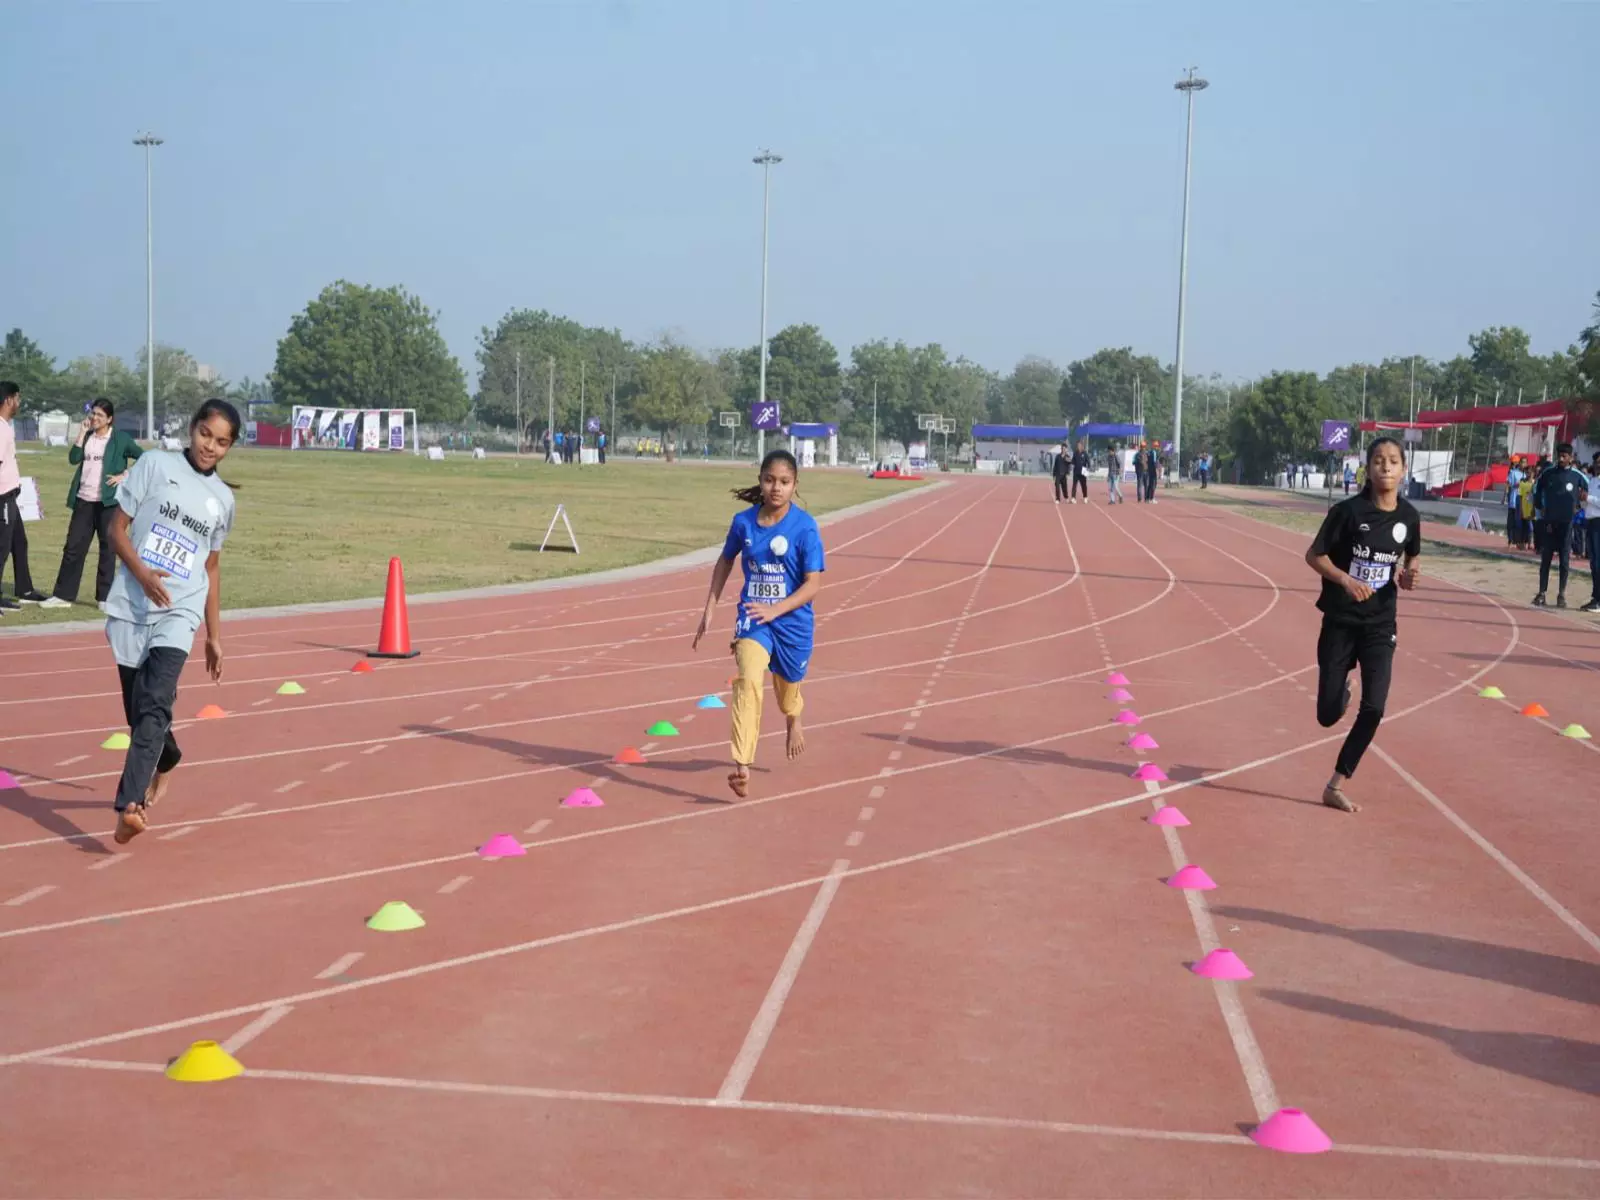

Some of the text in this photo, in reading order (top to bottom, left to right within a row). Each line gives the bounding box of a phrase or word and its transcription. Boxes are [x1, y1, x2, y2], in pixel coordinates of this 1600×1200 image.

[160, 501, 210, 537] ખેલે સાણંદ
[155, 537, 188, 565] 1874
[1355, 565, 1385, 580] 1934
[752, 583, 780, 597] 1893
